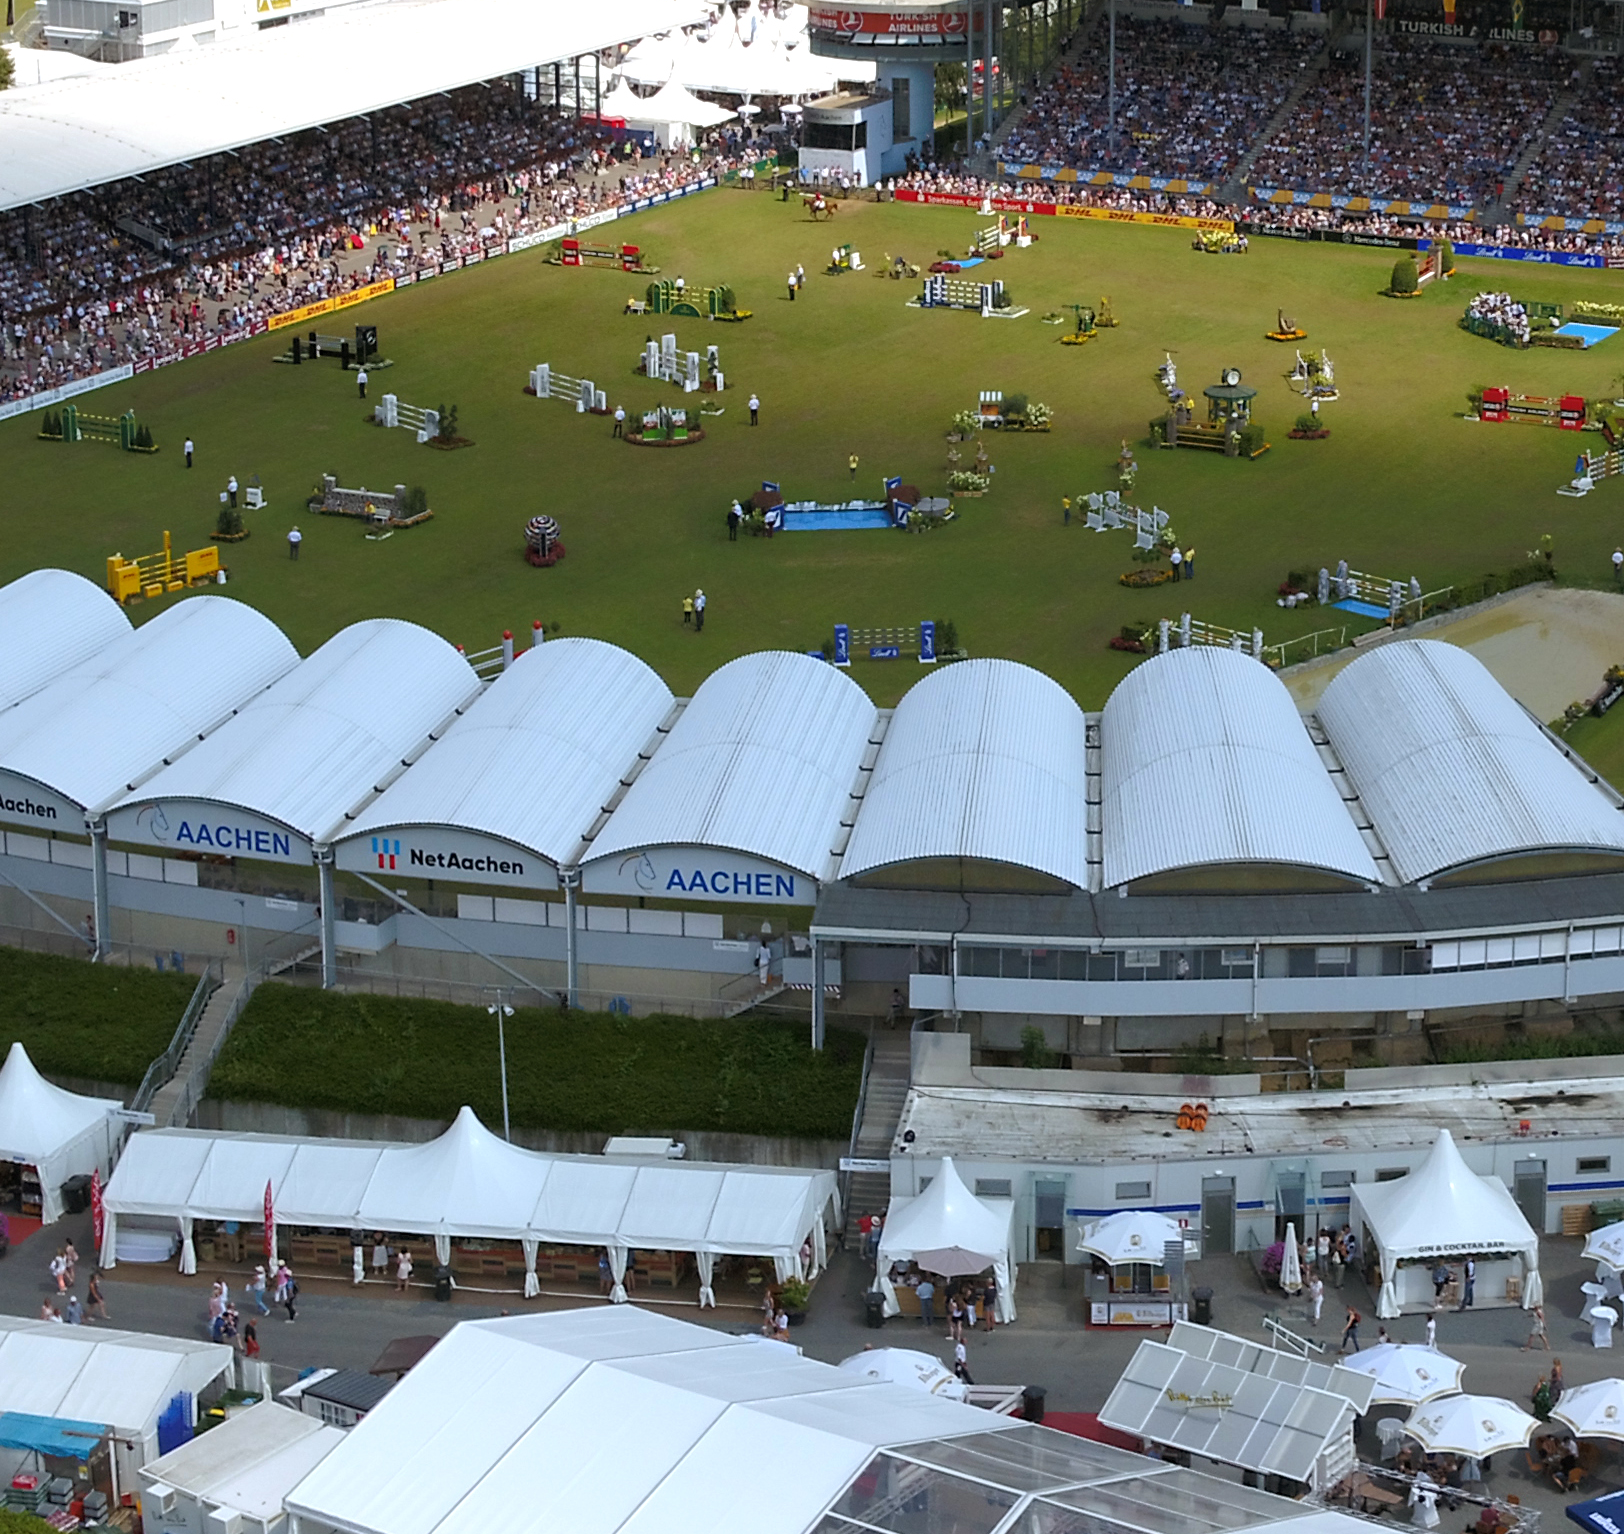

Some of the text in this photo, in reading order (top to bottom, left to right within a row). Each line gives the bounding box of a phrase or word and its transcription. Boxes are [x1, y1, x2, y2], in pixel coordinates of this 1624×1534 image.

[889, 22, 938, 33] AIRLINES
[1399, 21, 1463, 36] TURKISH
[1005, 165, 1020, 175] SAP
[1041, 167, 1057, 178] SAP
[1077, 170, 1093, 181] SAP
[1114, 173, 1130, 184] SAP
[1151, 177, 1167, 188] SAP
[1188, 181, 1204, 192] SAP
[1257, 188, 1272, 199] SAP
[1294, 193, 1310, 203] SAP
[1331, 197, 1348, 207] SAP
[1371, 201, 1387, 211] SAP
[1065, 208, 1093, 217] DHL
[1410, 205, 1426, 215] SAP
[1448, 209, 1465, 219] SAP
[1109, 212, 1136, 221] DHL
[1152, 216, 1180, 225] DHL
[1525, 216, 1543, 227] SAP
[1197, 220, 1225, 230] DHL
[1565, 220, 1583, 231] SAP
[1606, 224, 1624, 235] SAP
[1475, 246, 1498, 257] Lindt
[1523, 252, 1546, 261] Lindt
[1567, 256, 1590, 266] Lindt
[873, 648, 891, 657] Lindt
[176, 821, 290, 855] AACHEN
[410, 849, 524, 875] NetAachen
[666, 869, 794, 897] AACHEN
[1444, 1242, 1485, 1251] COCKTAIL
